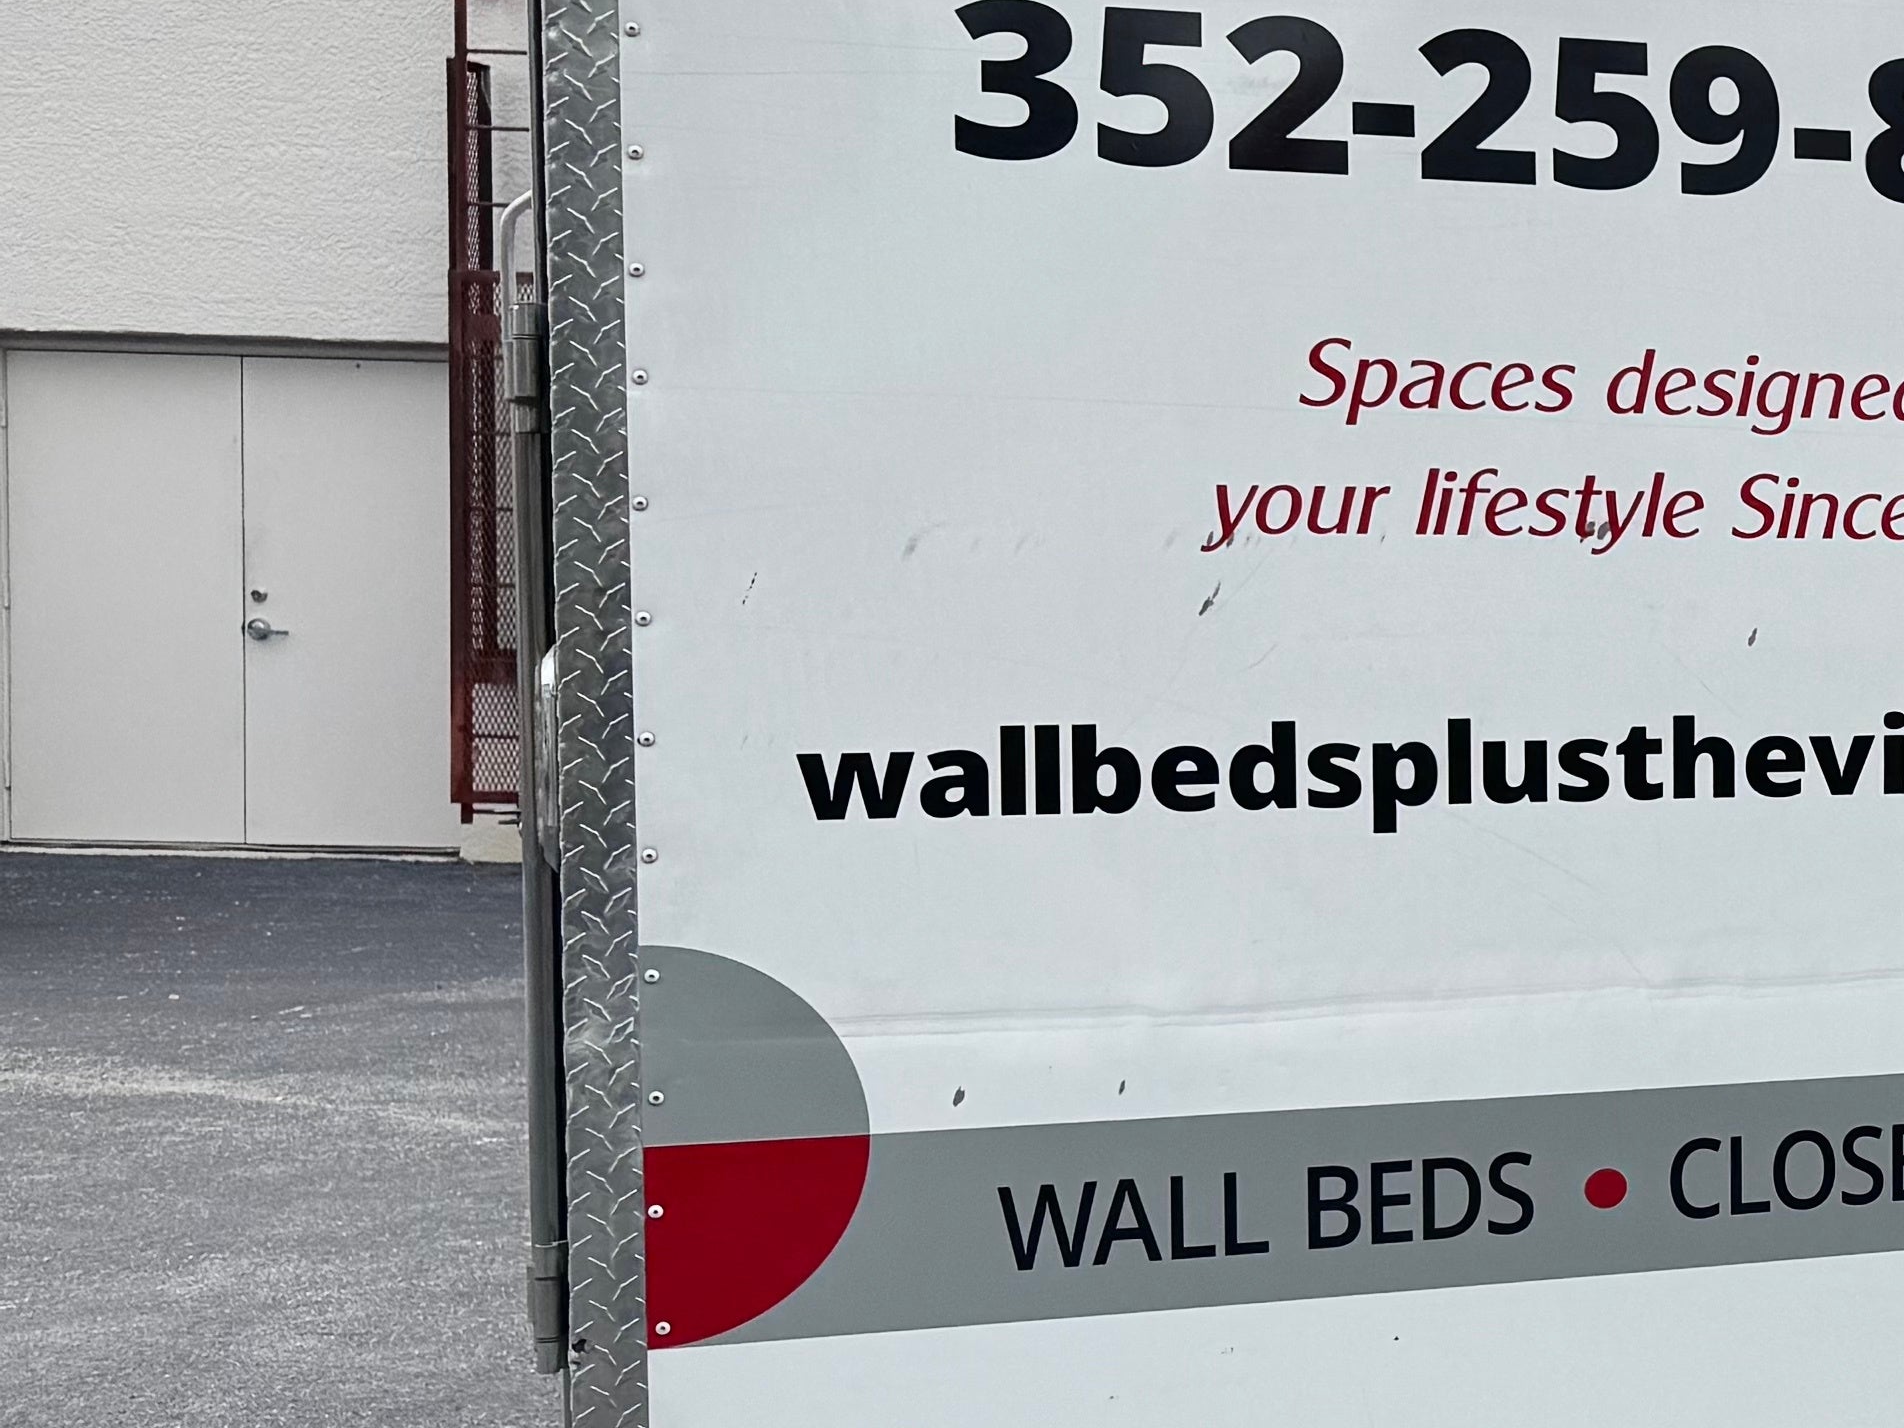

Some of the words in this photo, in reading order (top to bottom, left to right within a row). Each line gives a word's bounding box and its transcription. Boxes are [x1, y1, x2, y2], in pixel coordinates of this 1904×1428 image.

[1301, 339, 1575, 425] Spaces
[1203, 485, 1390, 553] your
[1416, 470, 1705, 555] lifestyle
[997, 1171, 1270, 1271] WALL
[1307, 1151, 1535, 1250] BEDS
